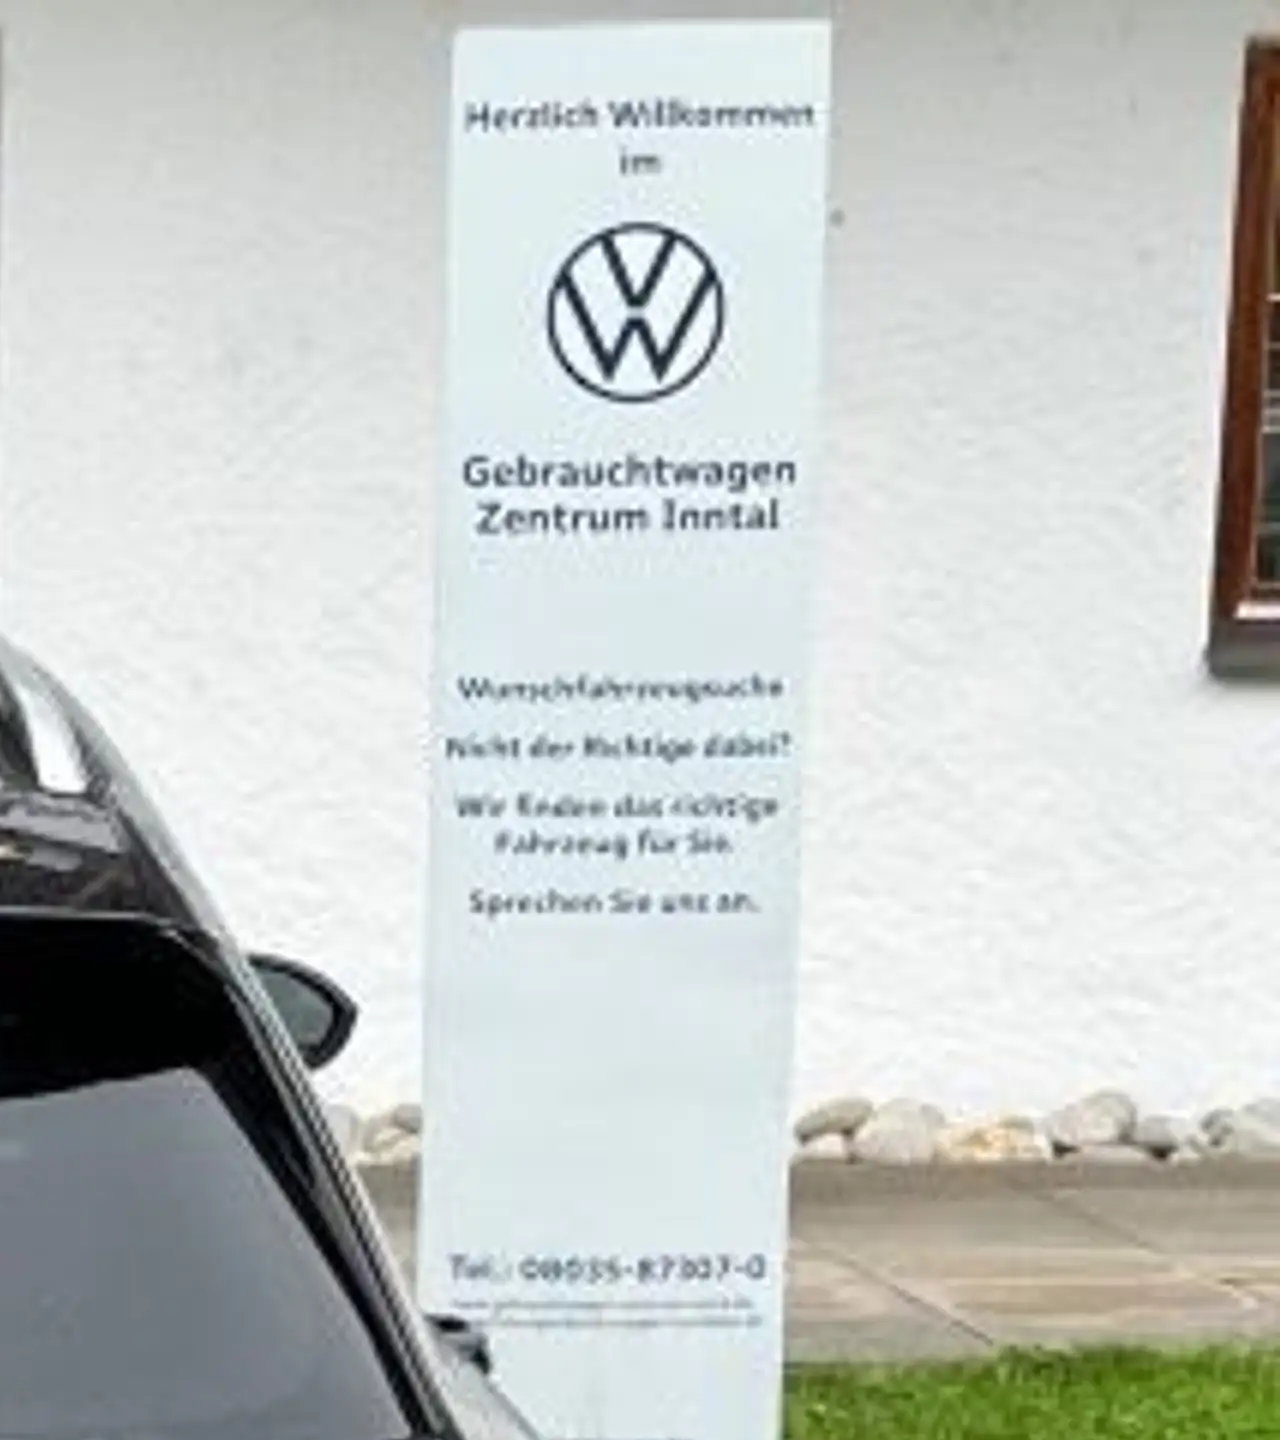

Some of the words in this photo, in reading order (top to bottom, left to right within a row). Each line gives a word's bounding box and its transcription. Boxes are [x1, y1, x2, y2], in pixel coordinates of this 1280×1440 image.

[465, 100, 598, 132] Herzlich
[606, 99, 815, 131] Willkommen
[619, 146, 663, 176] im
[461, 455, 797, 493] Gebrauchtwagen
[475, 500, 650, 535] Zentrum
[661, 498, 780, 532] Inntal
[444, 733, 521, 759] Nicht
[528, 735, 576, 759] der
[583, 733, 698, 763] Richtige
[702, 731, 793, 759] dabei?
[454, 793, 507, 819] Wir
[516, 793, 608, 819] finden
[613, 794, 665, 819] das
[670, 793, 779, 824] richtige
[493, 829, 630, 860] Fahrzeug
[468, 888, 604, 920] Sprechen
[608, 889, 653, 915] Sie
[659, 892, 711, 915] uns
